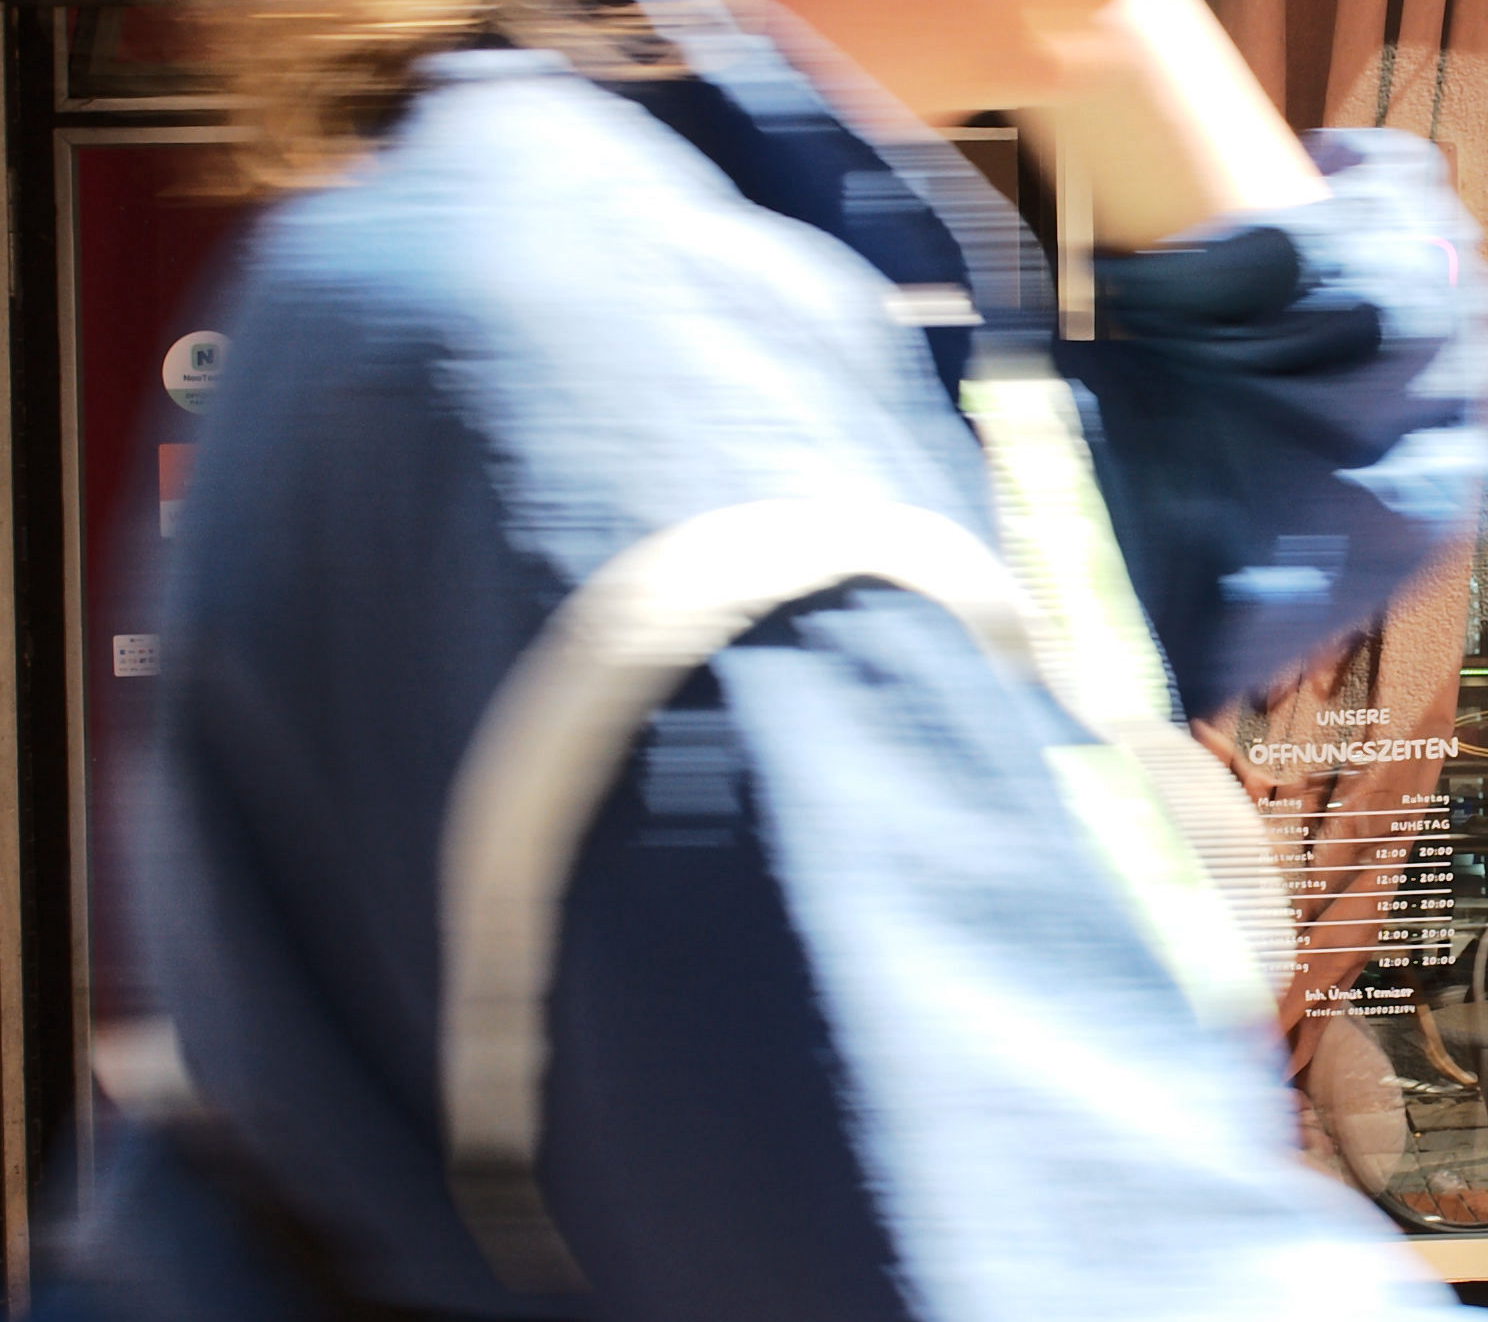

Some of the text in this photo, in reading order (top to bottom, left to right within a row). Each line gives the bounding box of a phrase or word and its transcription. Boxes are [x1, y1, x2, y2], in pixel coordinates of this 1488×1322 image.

[1316, 708, 1391, 726] UNSERE
[1249, 737, 1459, 765] ÖFFNUNGSZEITEN
[1257, 794, 1450, 809] Montag Ruhetag
[1391, 819, 1450, 832] RUHETAG
[1376, 848, 1407, 860] 12:00
[1419, 846, 1454, 857] 20:00
[1376, 874, 1407, 886] 12:00
[1420, 872, 1454, 884] 20:00
[1377, 900, 1408, 912] 12:00
[1420, 898, 1455, 910] 20:00
[1378, 929, 1409, 941] 12:00
[1421, 928, 1456, 939] 20:00
[1379, 957, 1410, 968] 12:00
[1422, 955, 1456, 967] 20:00
